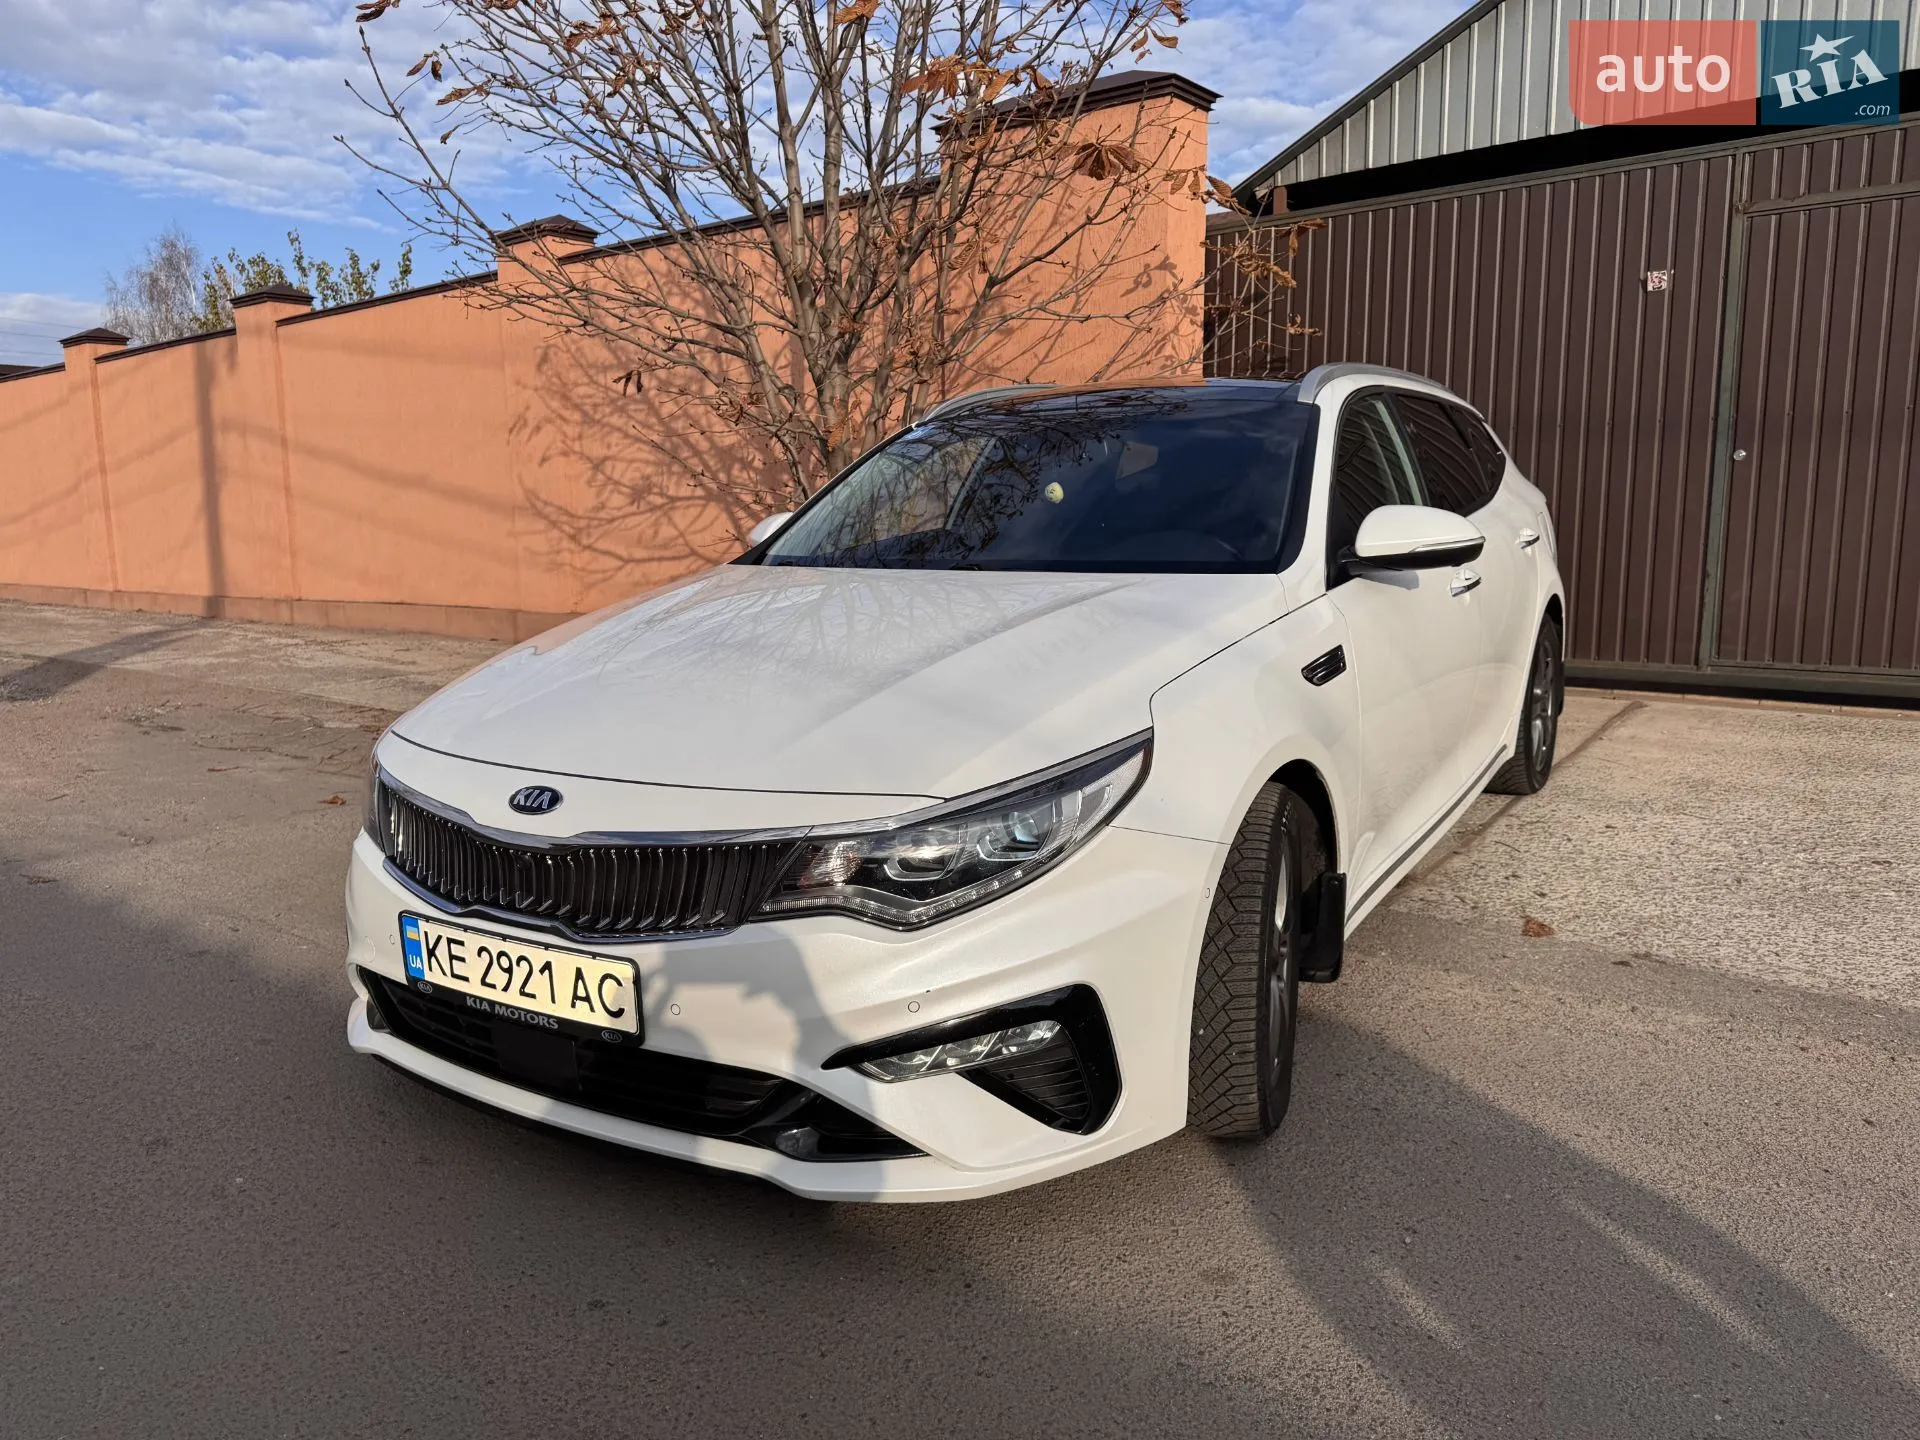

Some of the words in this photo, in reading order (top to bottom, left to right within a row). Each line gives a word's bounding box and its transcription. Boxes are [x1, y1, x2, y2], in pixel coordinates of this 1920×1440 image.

[513, 788, 552, 809] KIA
[409, 957, 423, 970] UA
[424, 930, 470, 982] KE
[477, 945, 556, 1004] 2921
[570, 966, 626, 1018] AC
[466, 995, 490, 1013] KIA
[494, 1003, 559, 1029] MOTORS
